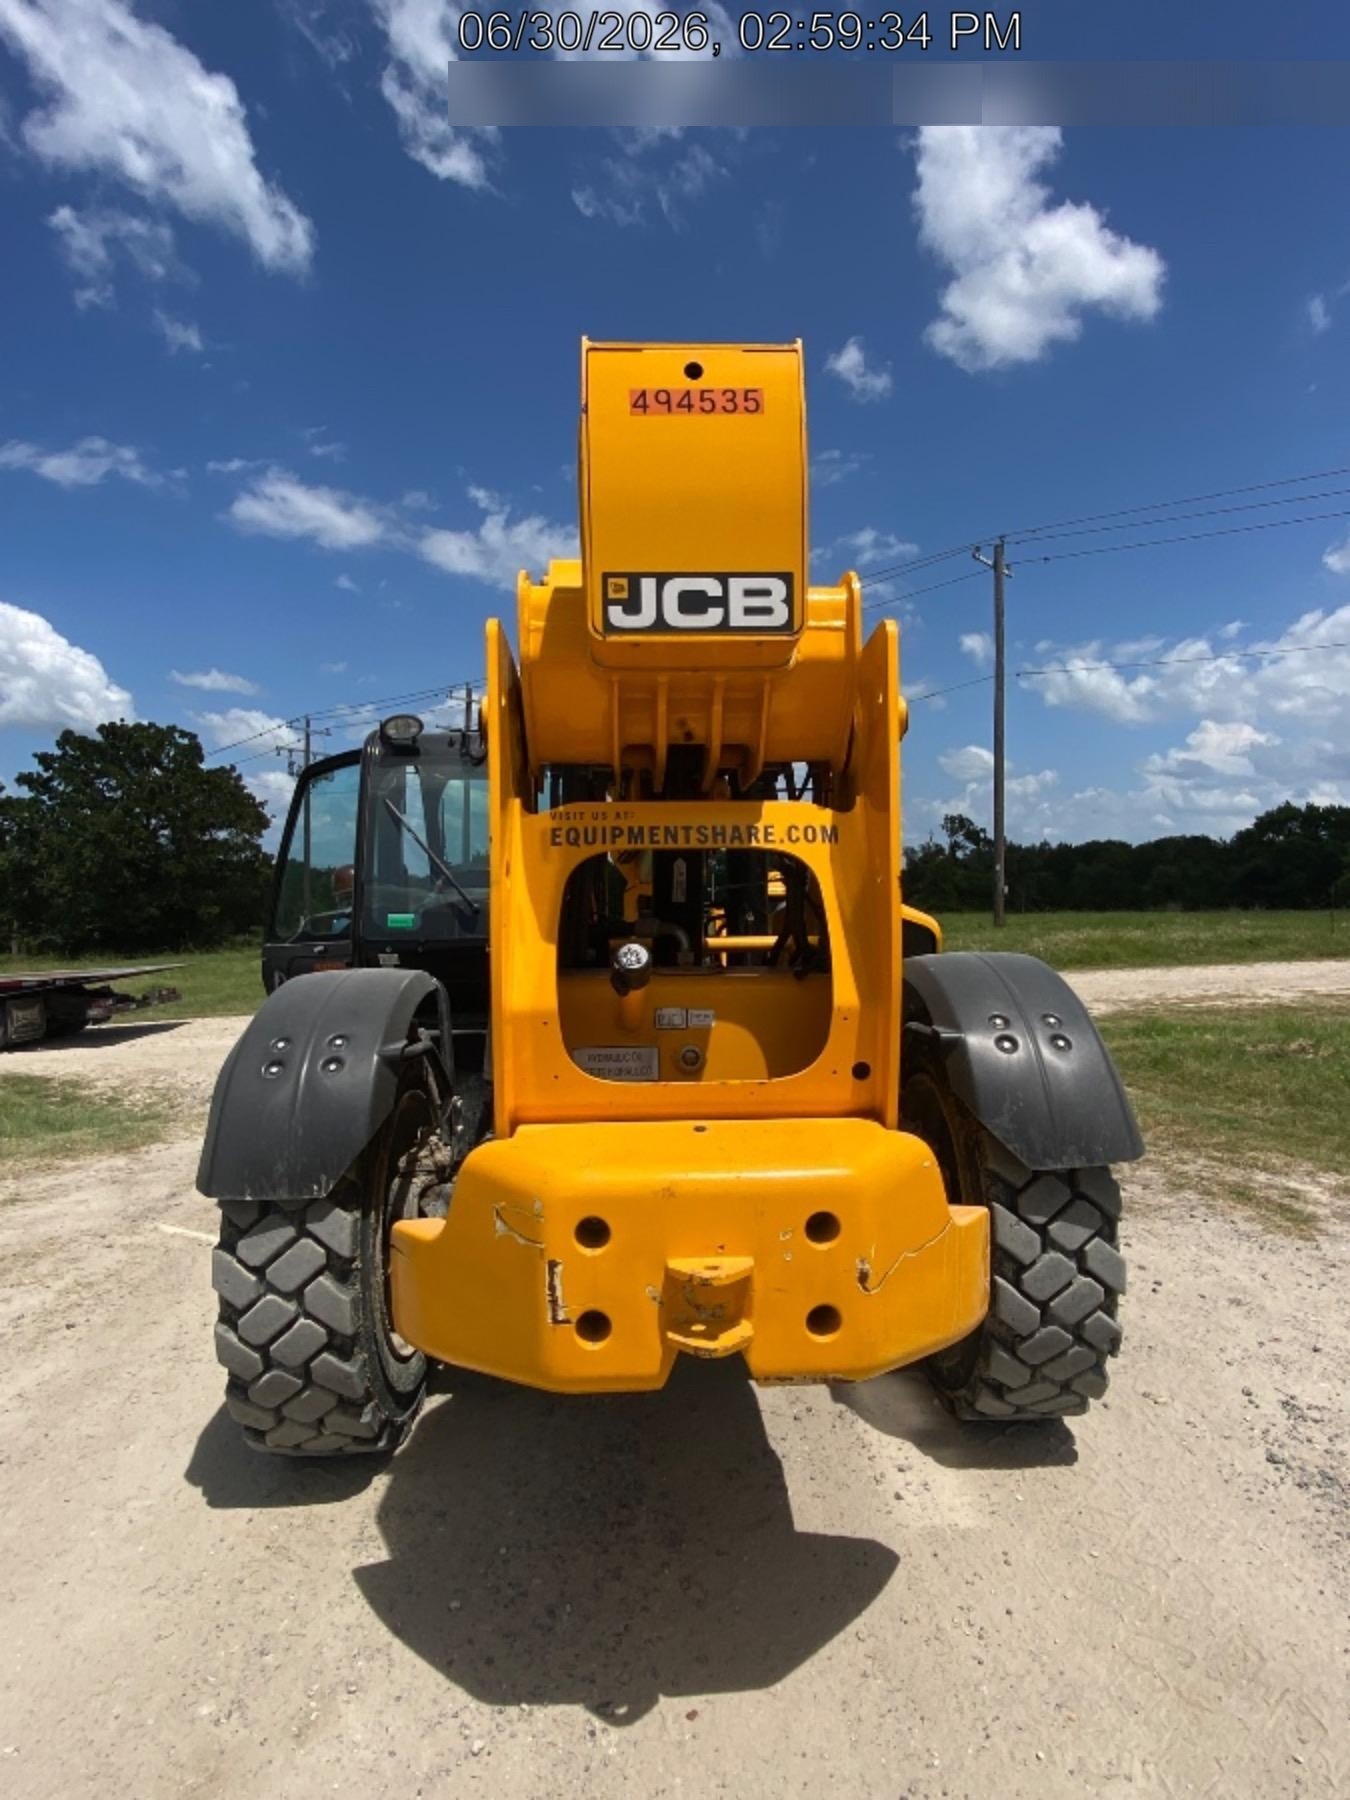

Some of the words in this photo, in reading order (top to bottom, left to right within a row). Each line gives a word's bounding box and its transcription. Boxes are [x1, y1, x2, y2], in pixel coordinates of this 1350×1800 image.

[631, 389, 761, 414] 494535
[607, 577, 789, 629] JCB
[550, 812, 584, 821] VISIT
[592, 812, 608, 821] US
[550, 824, 839, 847] EQUIPMENTSHARE.COM
